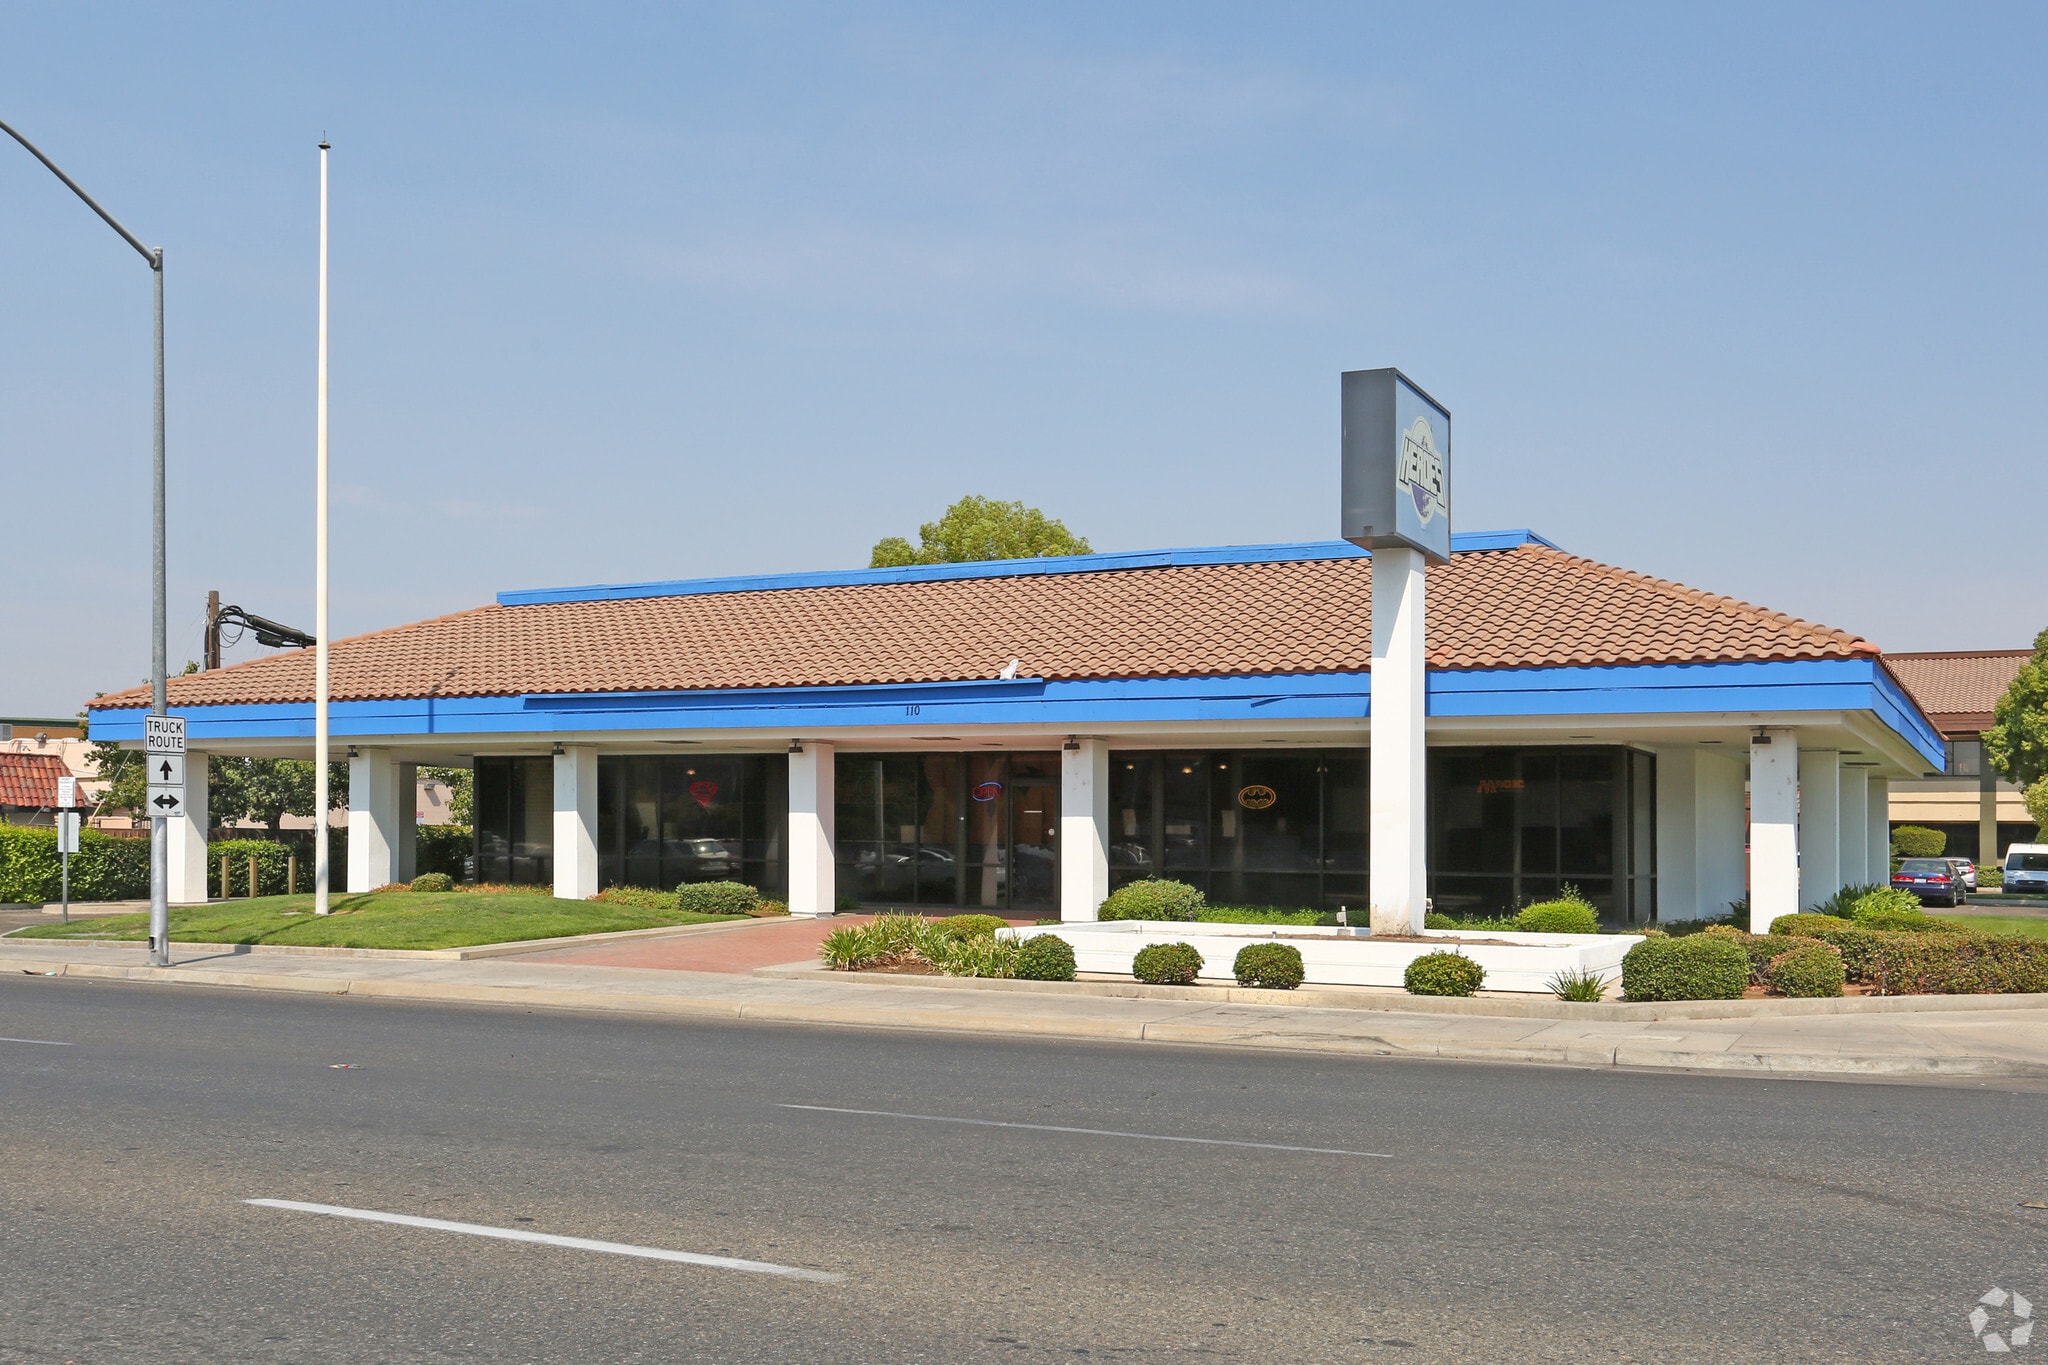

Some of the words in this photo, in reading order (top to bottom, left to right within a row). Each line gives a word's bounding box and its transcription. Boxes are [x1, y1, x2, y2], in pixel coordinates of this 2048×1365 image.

[1399, 436, 1446, 509] HEROES
[906, 705, 920, 716] 110
[147, 720, 183, 734] TRUCK
[148, 735, 184, 748] ROUTE
[972, 786, 1002, 799] OPEN
